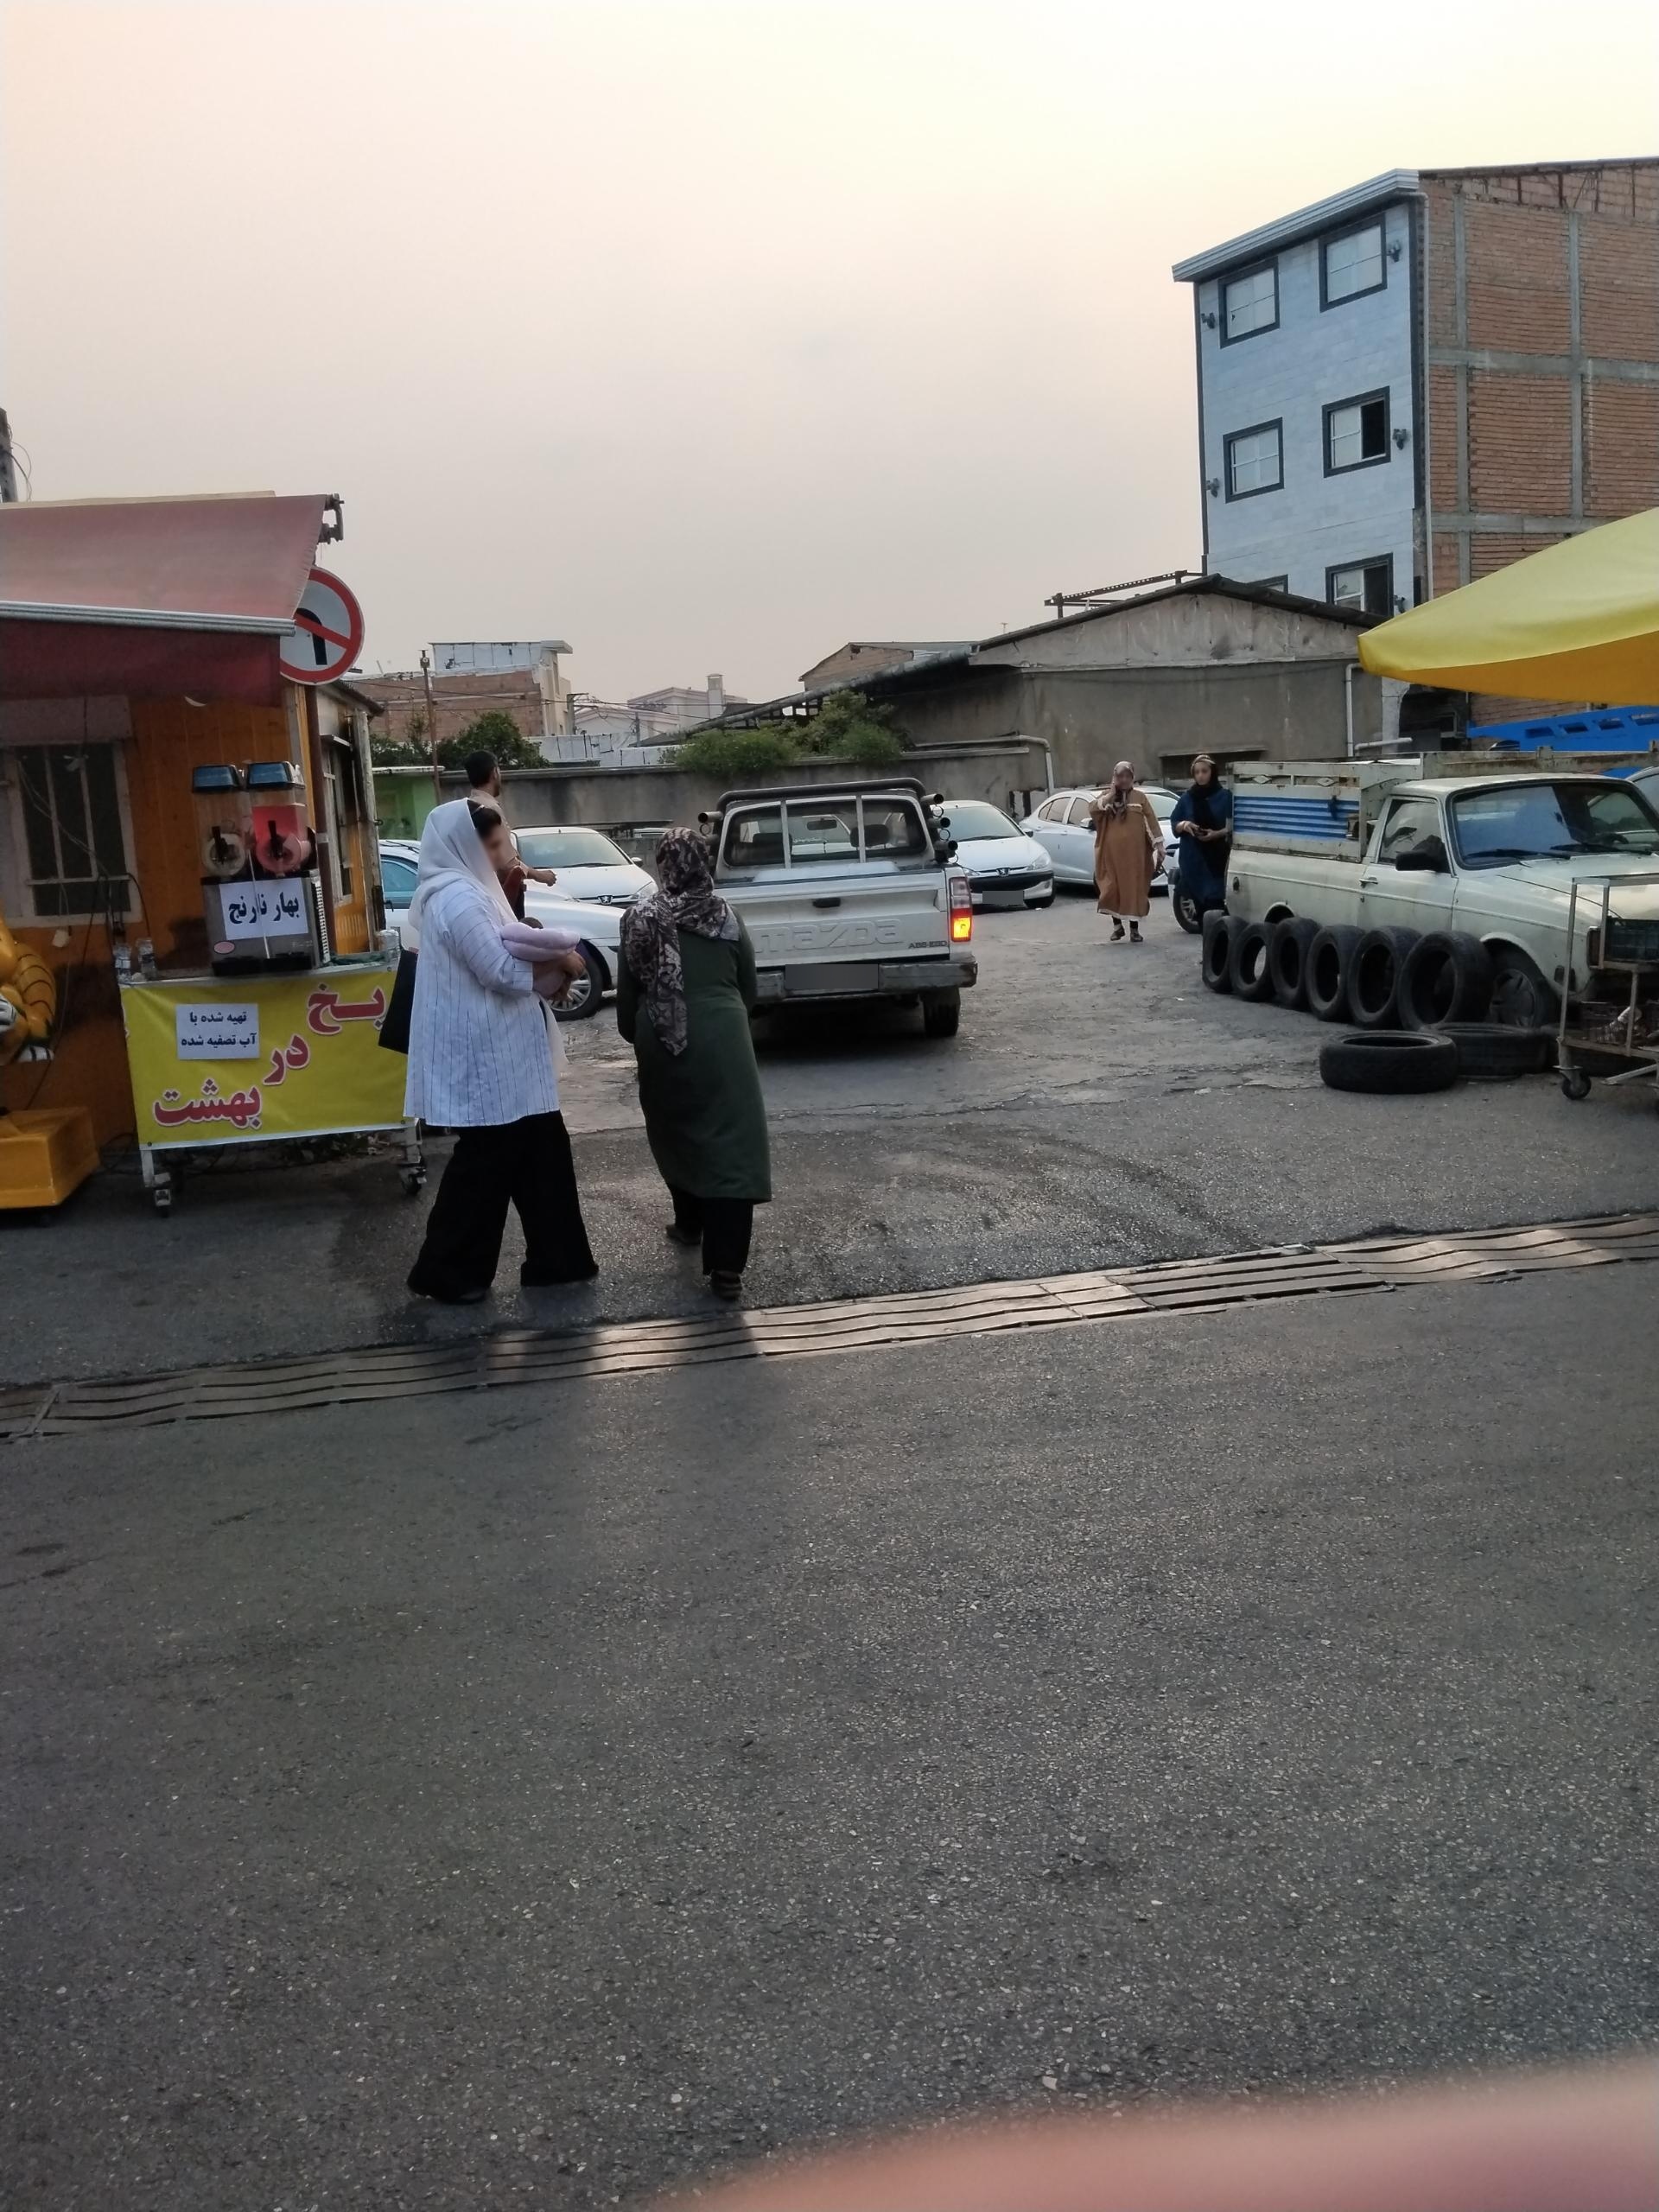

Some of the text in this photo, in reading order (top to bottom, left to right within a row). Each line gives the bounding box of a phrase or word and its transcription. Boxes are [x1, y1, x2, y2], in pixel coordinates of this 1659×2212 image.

[228, 891, 299, 925] بهار نارنج
[189, 1011, 247, 1026] تهیه شده با
[181, 1032, 257, 1049] آب تصفیه شده
[263, 1033, 310, 1085] در
[153, 1077, 262, 1129] بهشت
